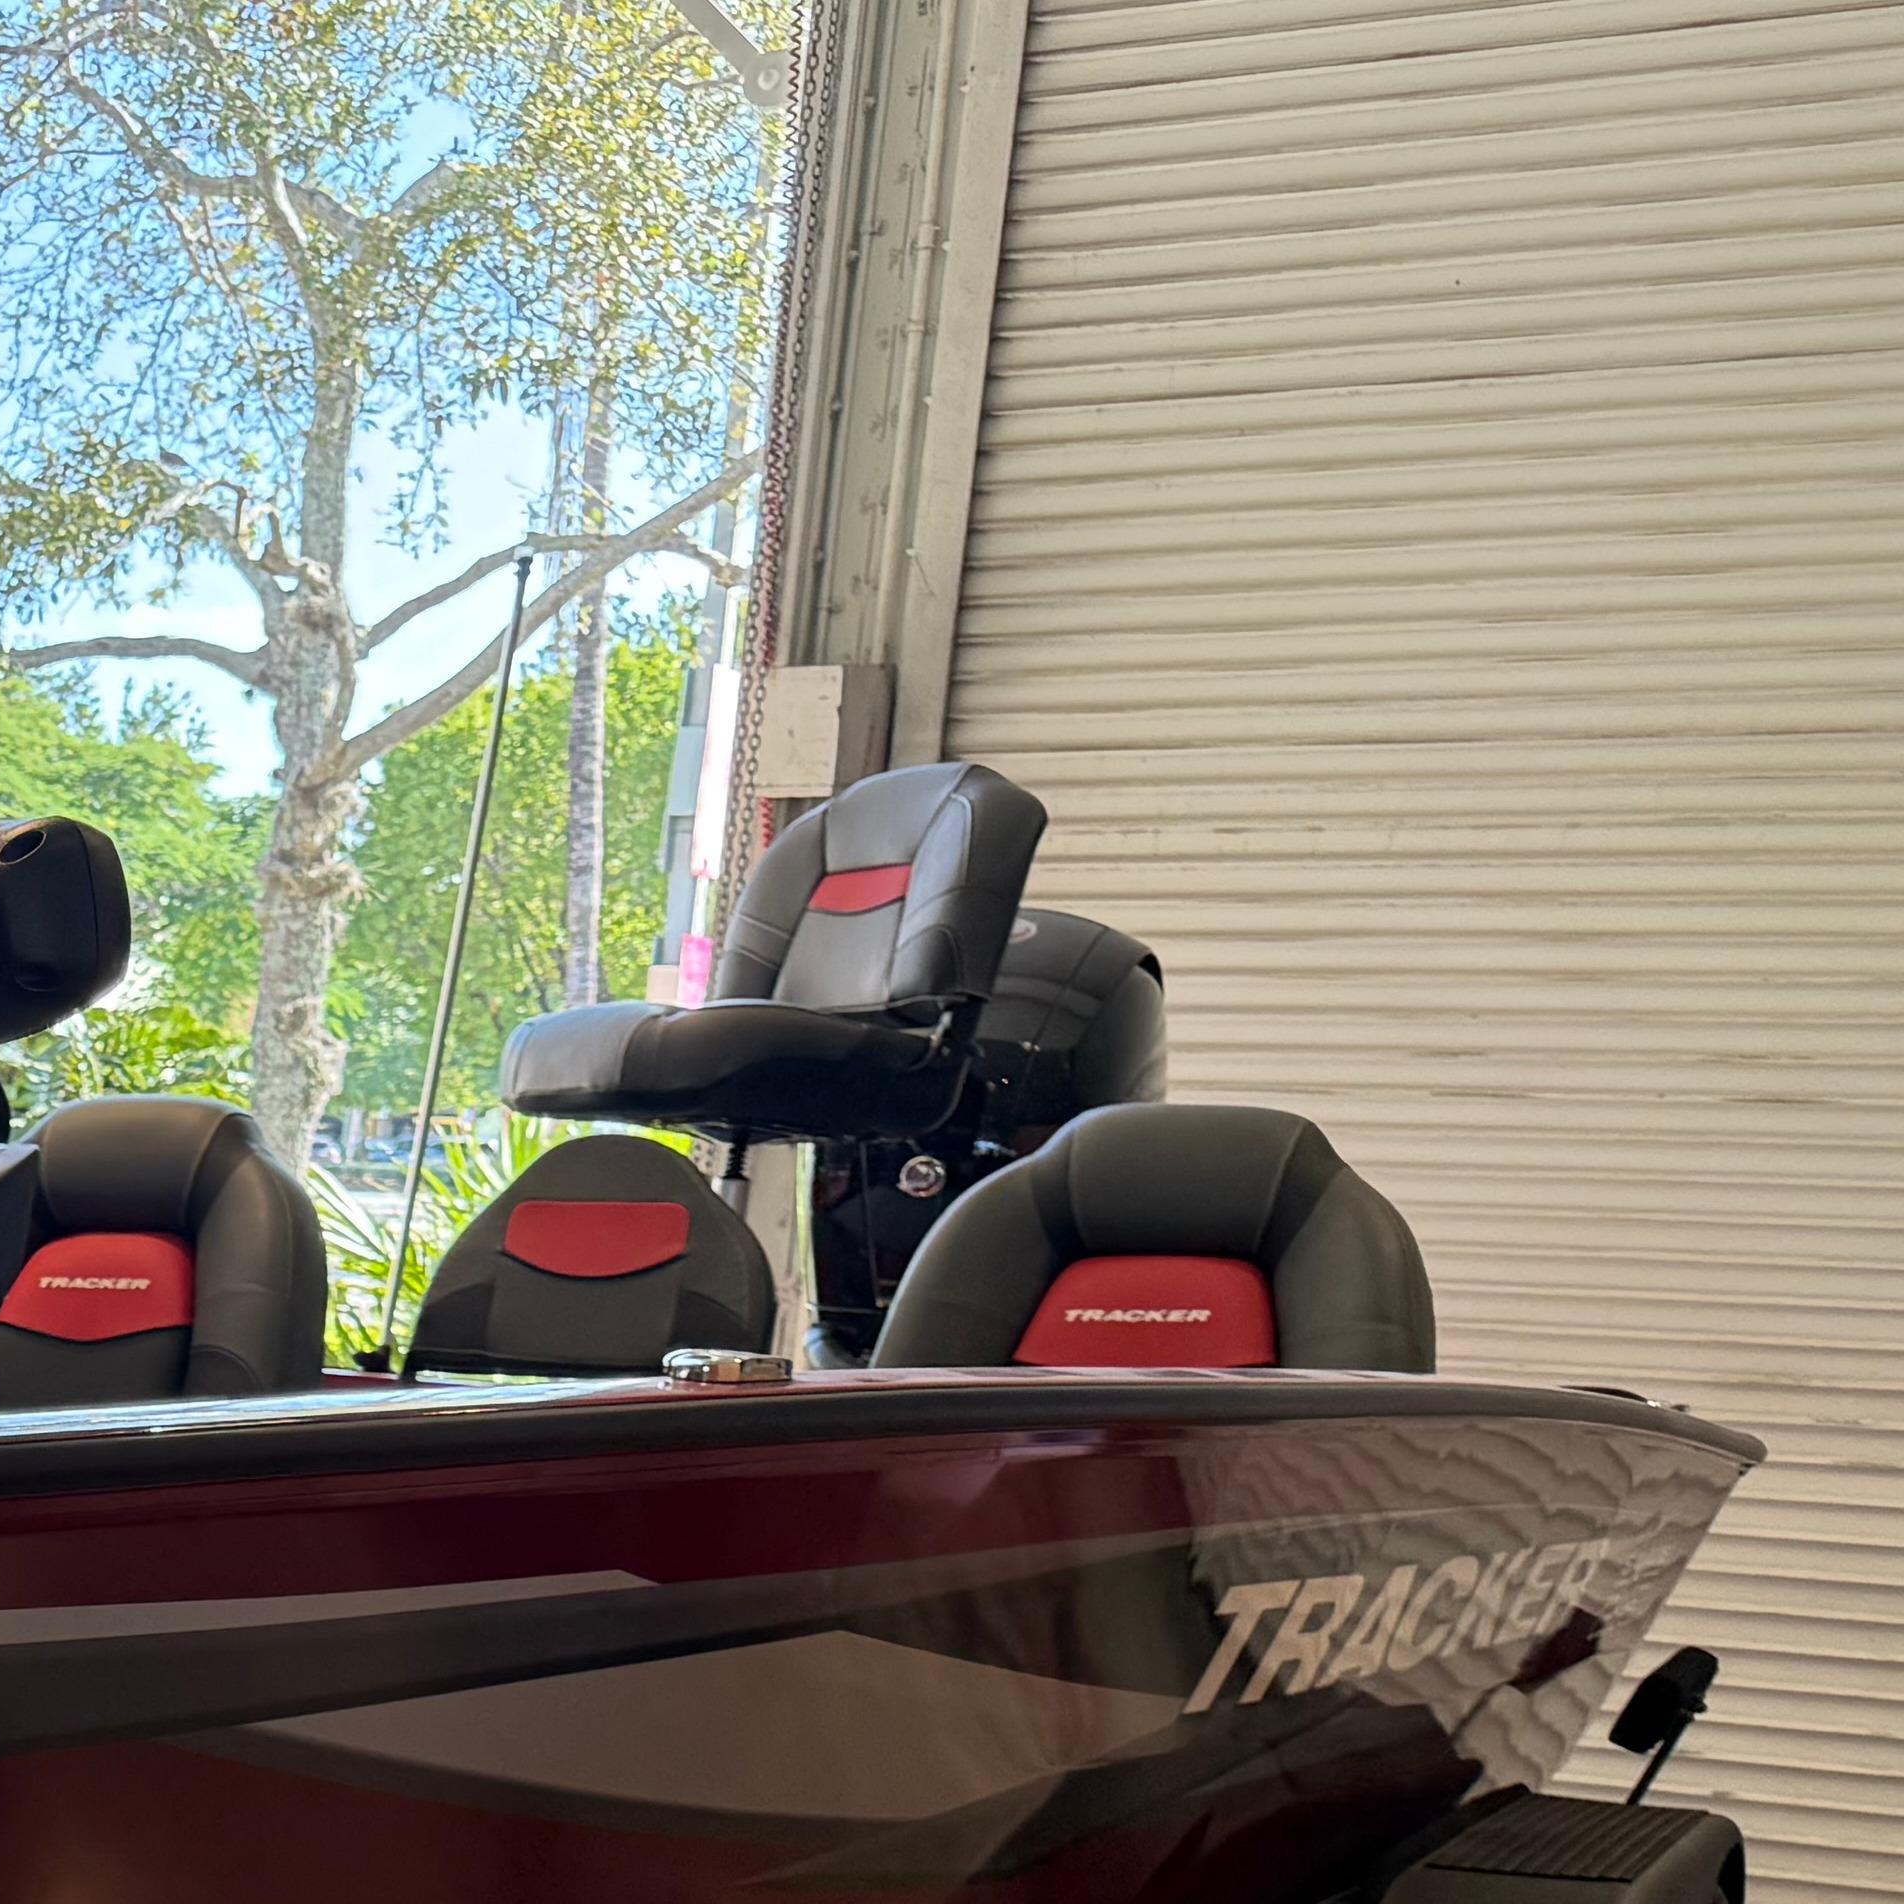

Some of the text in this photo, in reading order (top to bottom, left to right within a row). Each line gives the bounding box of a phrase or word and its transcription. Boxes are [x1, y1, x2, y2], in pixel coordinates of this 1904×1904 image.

[38, 1275, 151, 1292] TRACKER
[1064, 1308, 1212, 1324] TRACKER
[1182, 1538, 1610, 1715] TRACKER
